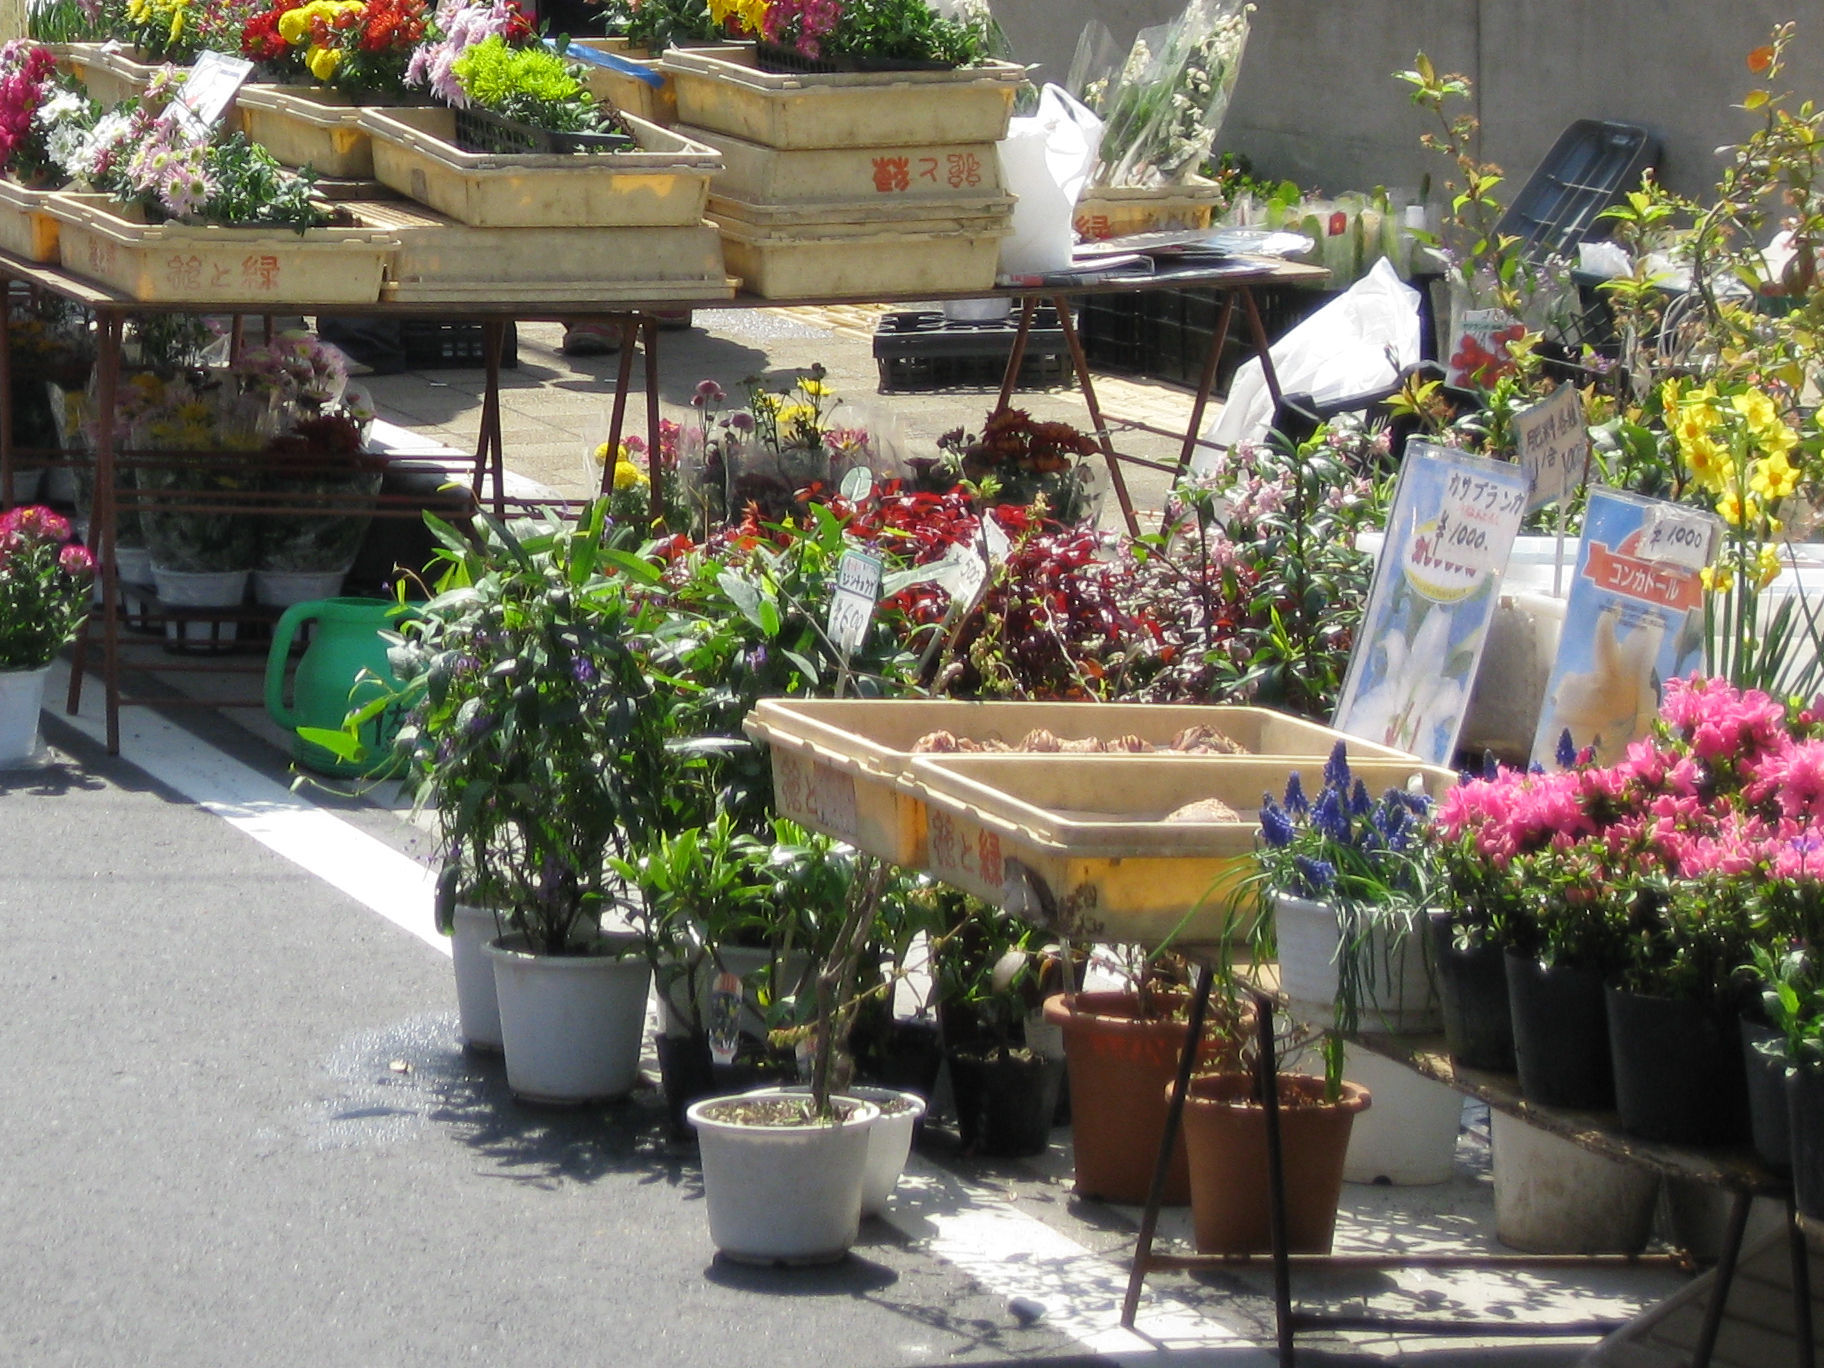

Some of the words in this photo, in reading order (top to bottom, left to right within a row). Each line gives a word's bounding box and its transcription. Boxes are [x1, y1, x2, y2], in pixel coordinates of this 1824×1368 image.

[1609, 563, 1679, 601] コンカドール
